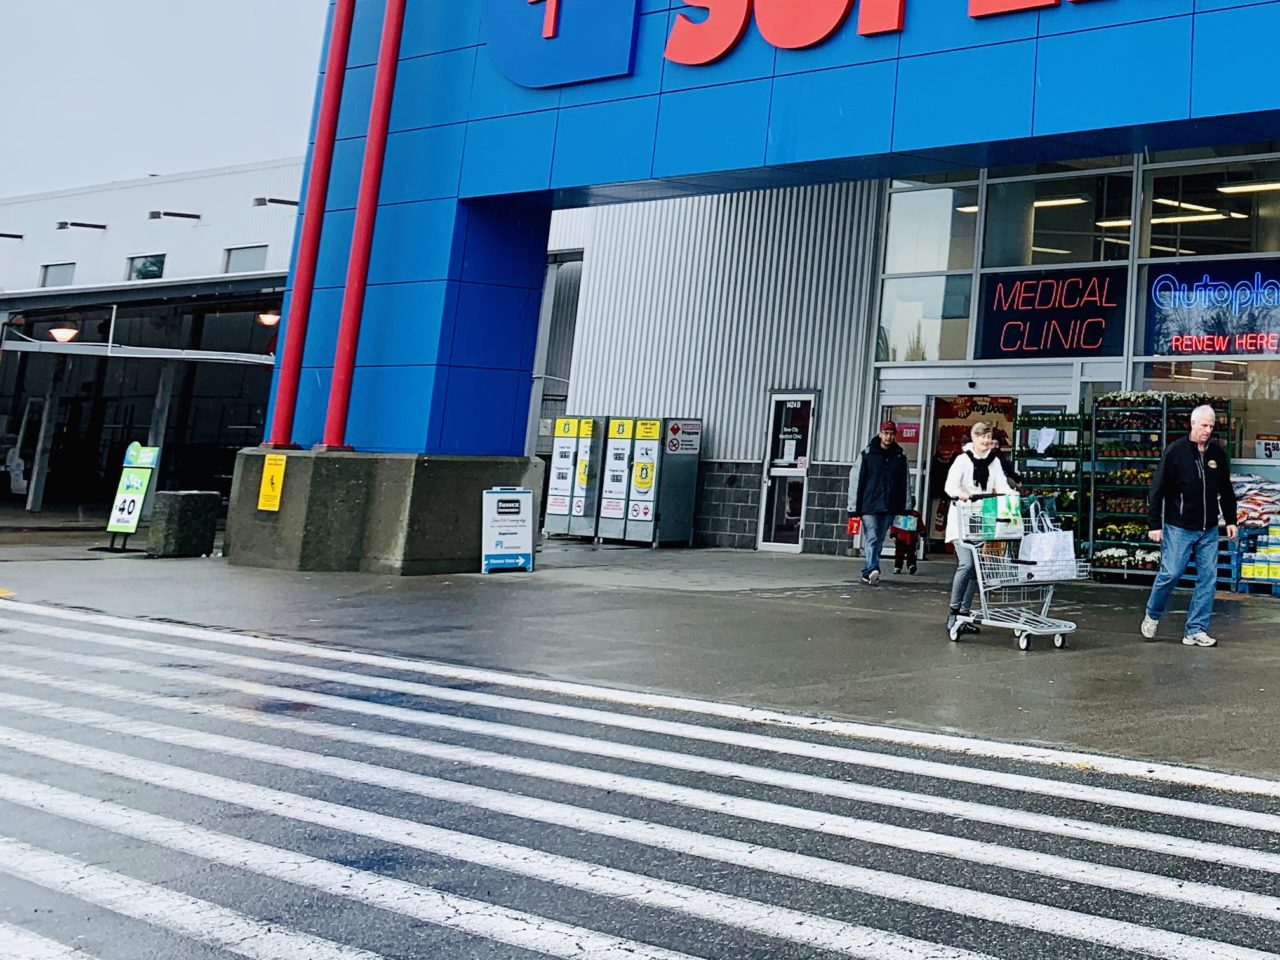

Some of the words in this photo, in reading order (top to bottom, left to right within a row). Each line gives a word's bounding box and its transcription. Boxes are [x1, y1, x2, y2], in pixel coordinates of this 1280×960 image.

[993, 276, 1117, 312] MEDICAL
[1000, 318, 1106, 352] CLINIC
[1171, 335, 1228, 352] RENEW
[1235, 333, 1279, 351] HERE
